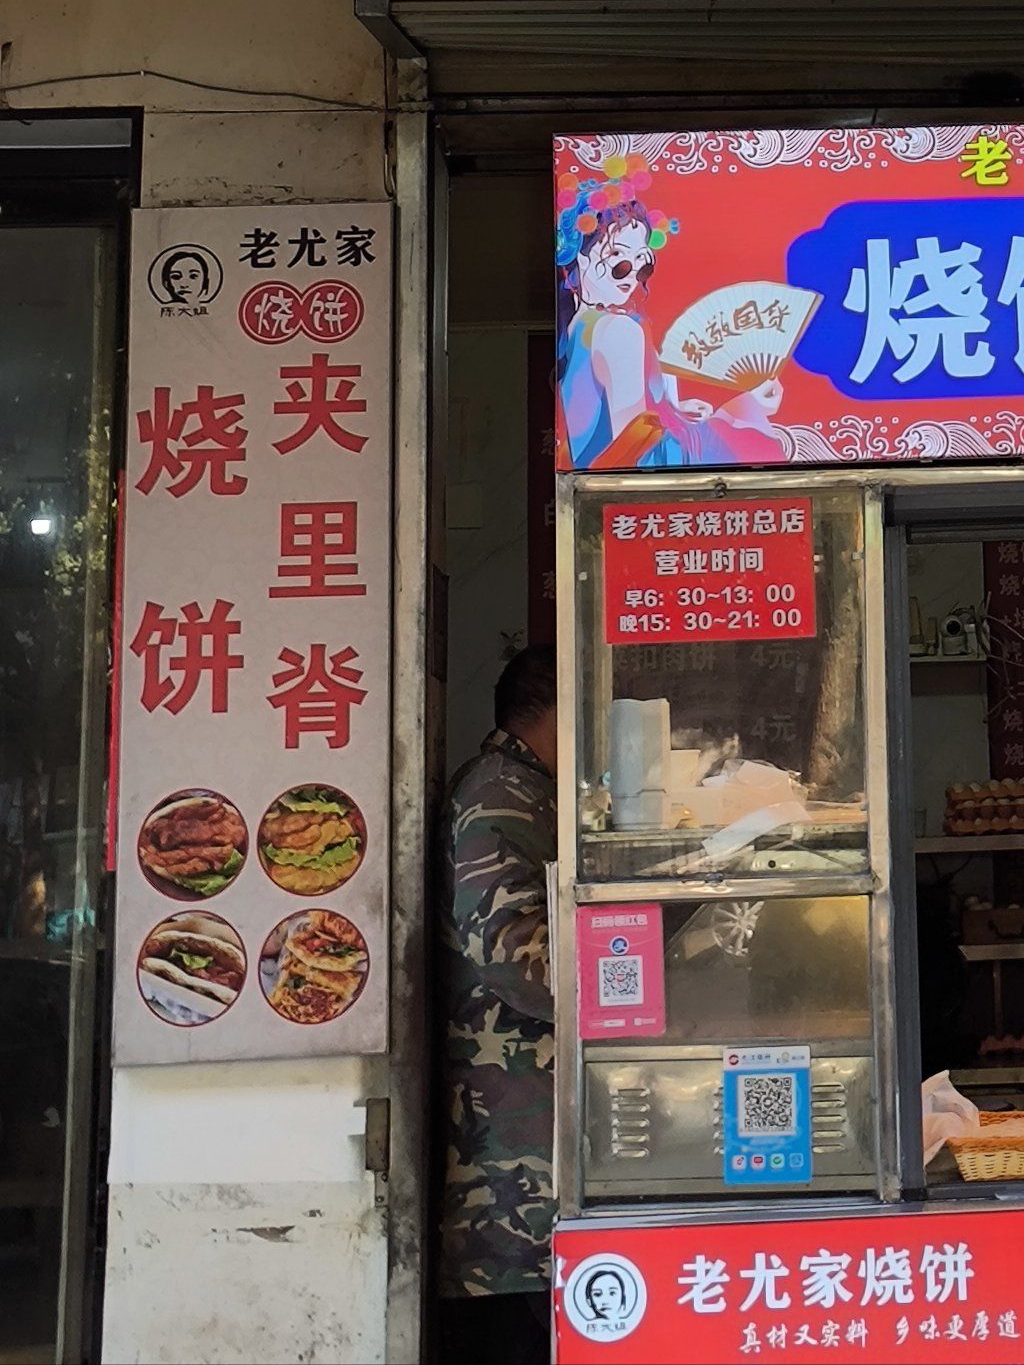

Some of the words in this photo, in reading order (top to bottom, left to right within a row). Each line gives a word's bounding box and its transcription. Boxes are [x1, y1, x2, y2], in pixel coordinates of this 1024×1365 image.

[239, 225, 377, 269] 老尤家
[254, 288, 348, 336] 烧饼
[612, 508, 805, 540] 老尤家烧饼总店
[129, 386, 248, 715] 烧饼
[266, 353, 369, 749] 夹里脊
[655, 548, 764, 576] 营业时间
[676, 1242, 974, 1313] 老尤家烧饼
